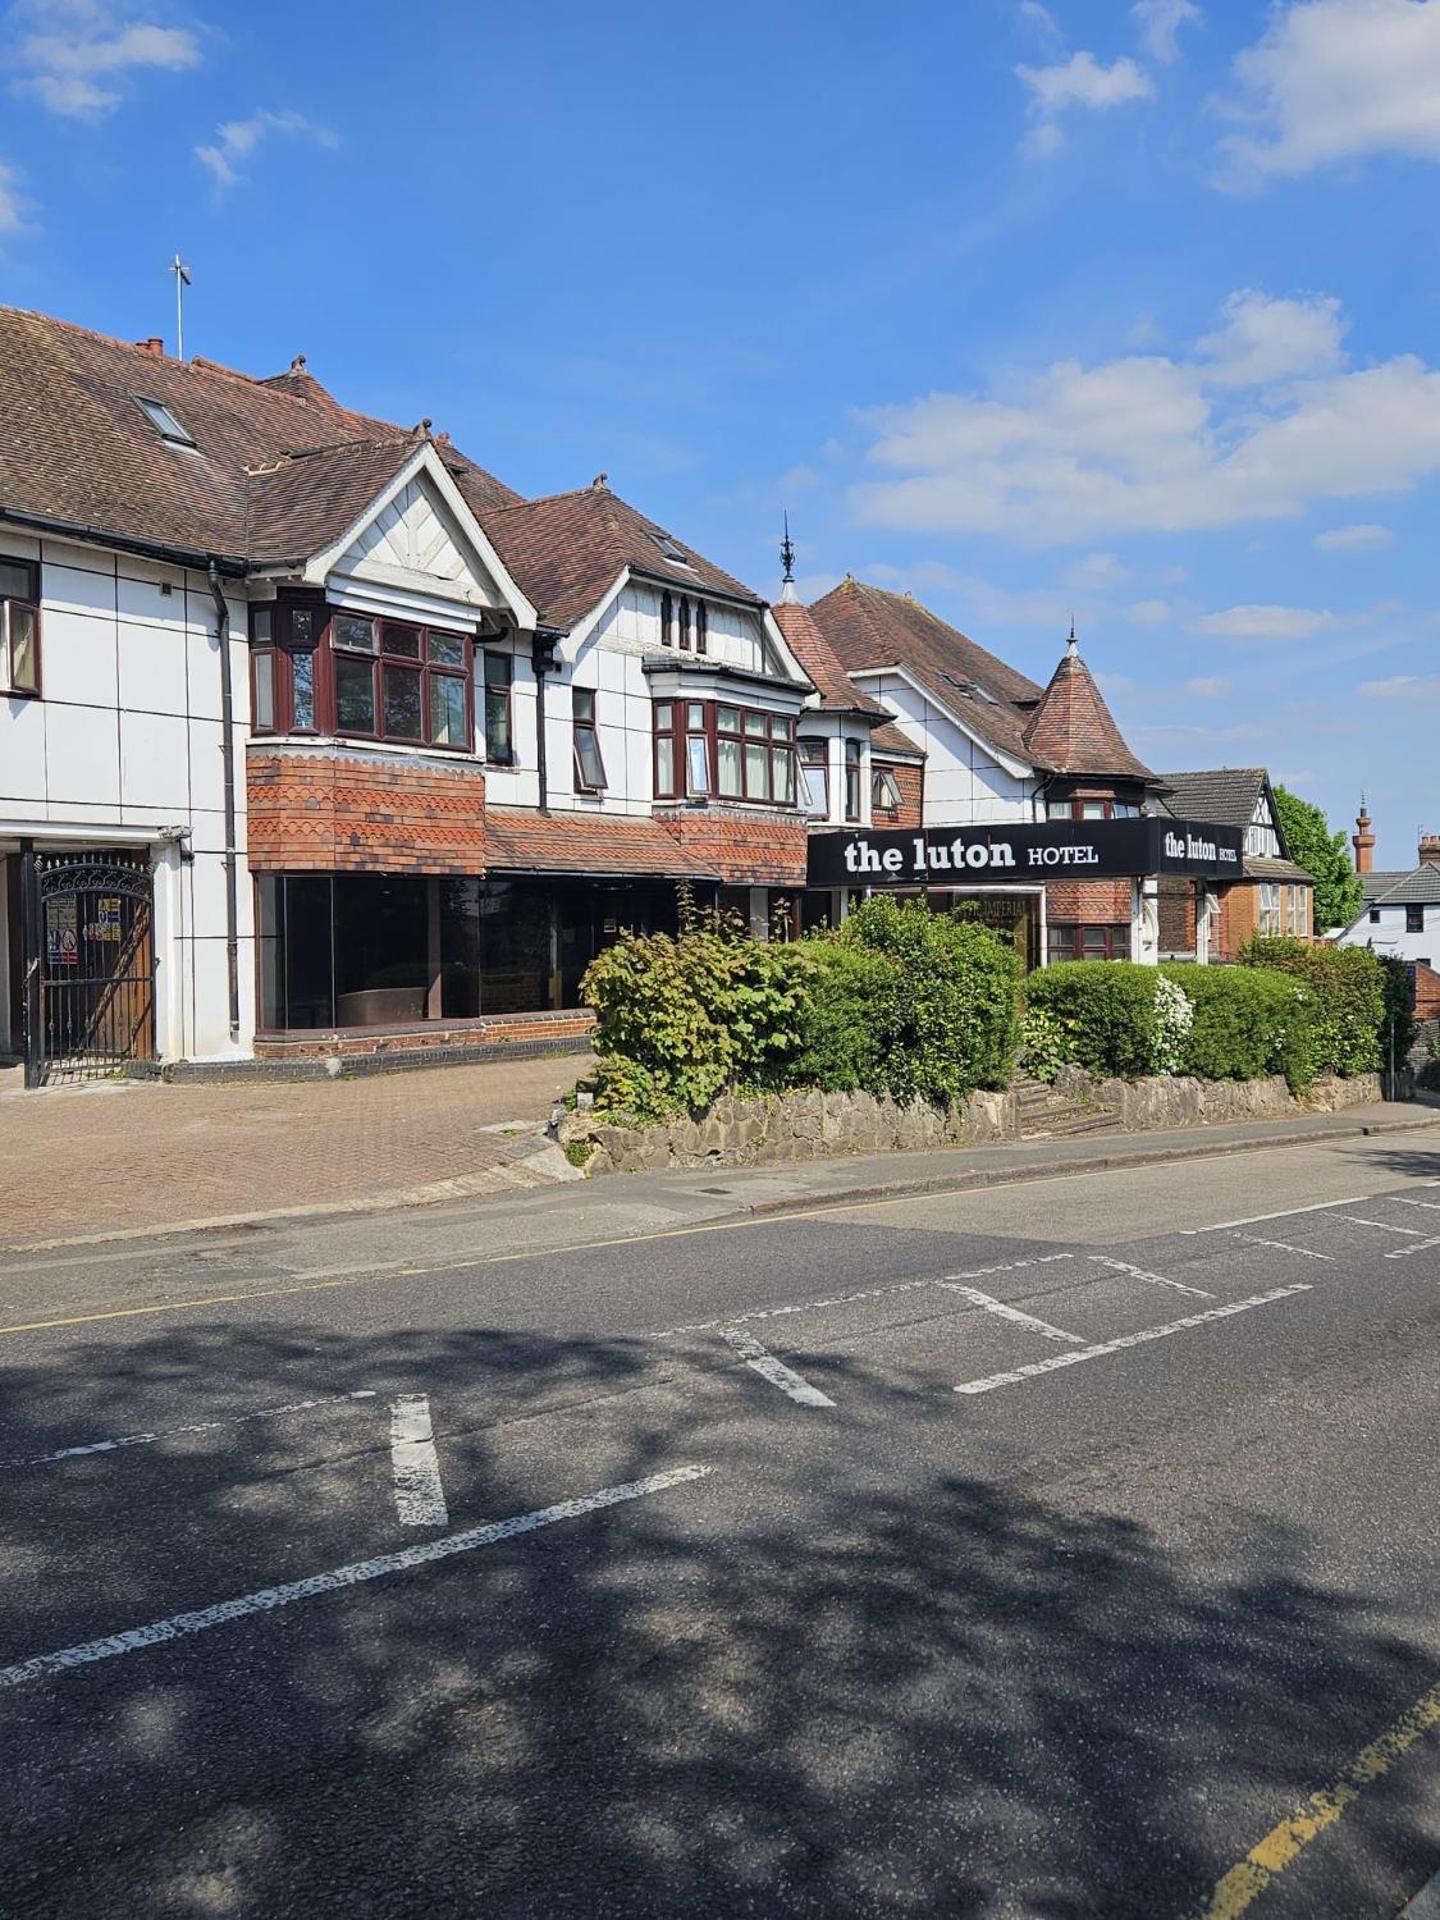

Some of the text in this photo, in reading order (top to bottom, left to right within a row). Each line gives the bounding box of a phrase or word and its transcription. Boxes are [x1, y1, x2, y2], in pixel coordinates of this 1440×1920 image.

[844, 838, 1099, 872] the luton HOTEL
[1165, 832, 1185, 858] the
[1187, 833, 1217, 861] luton
